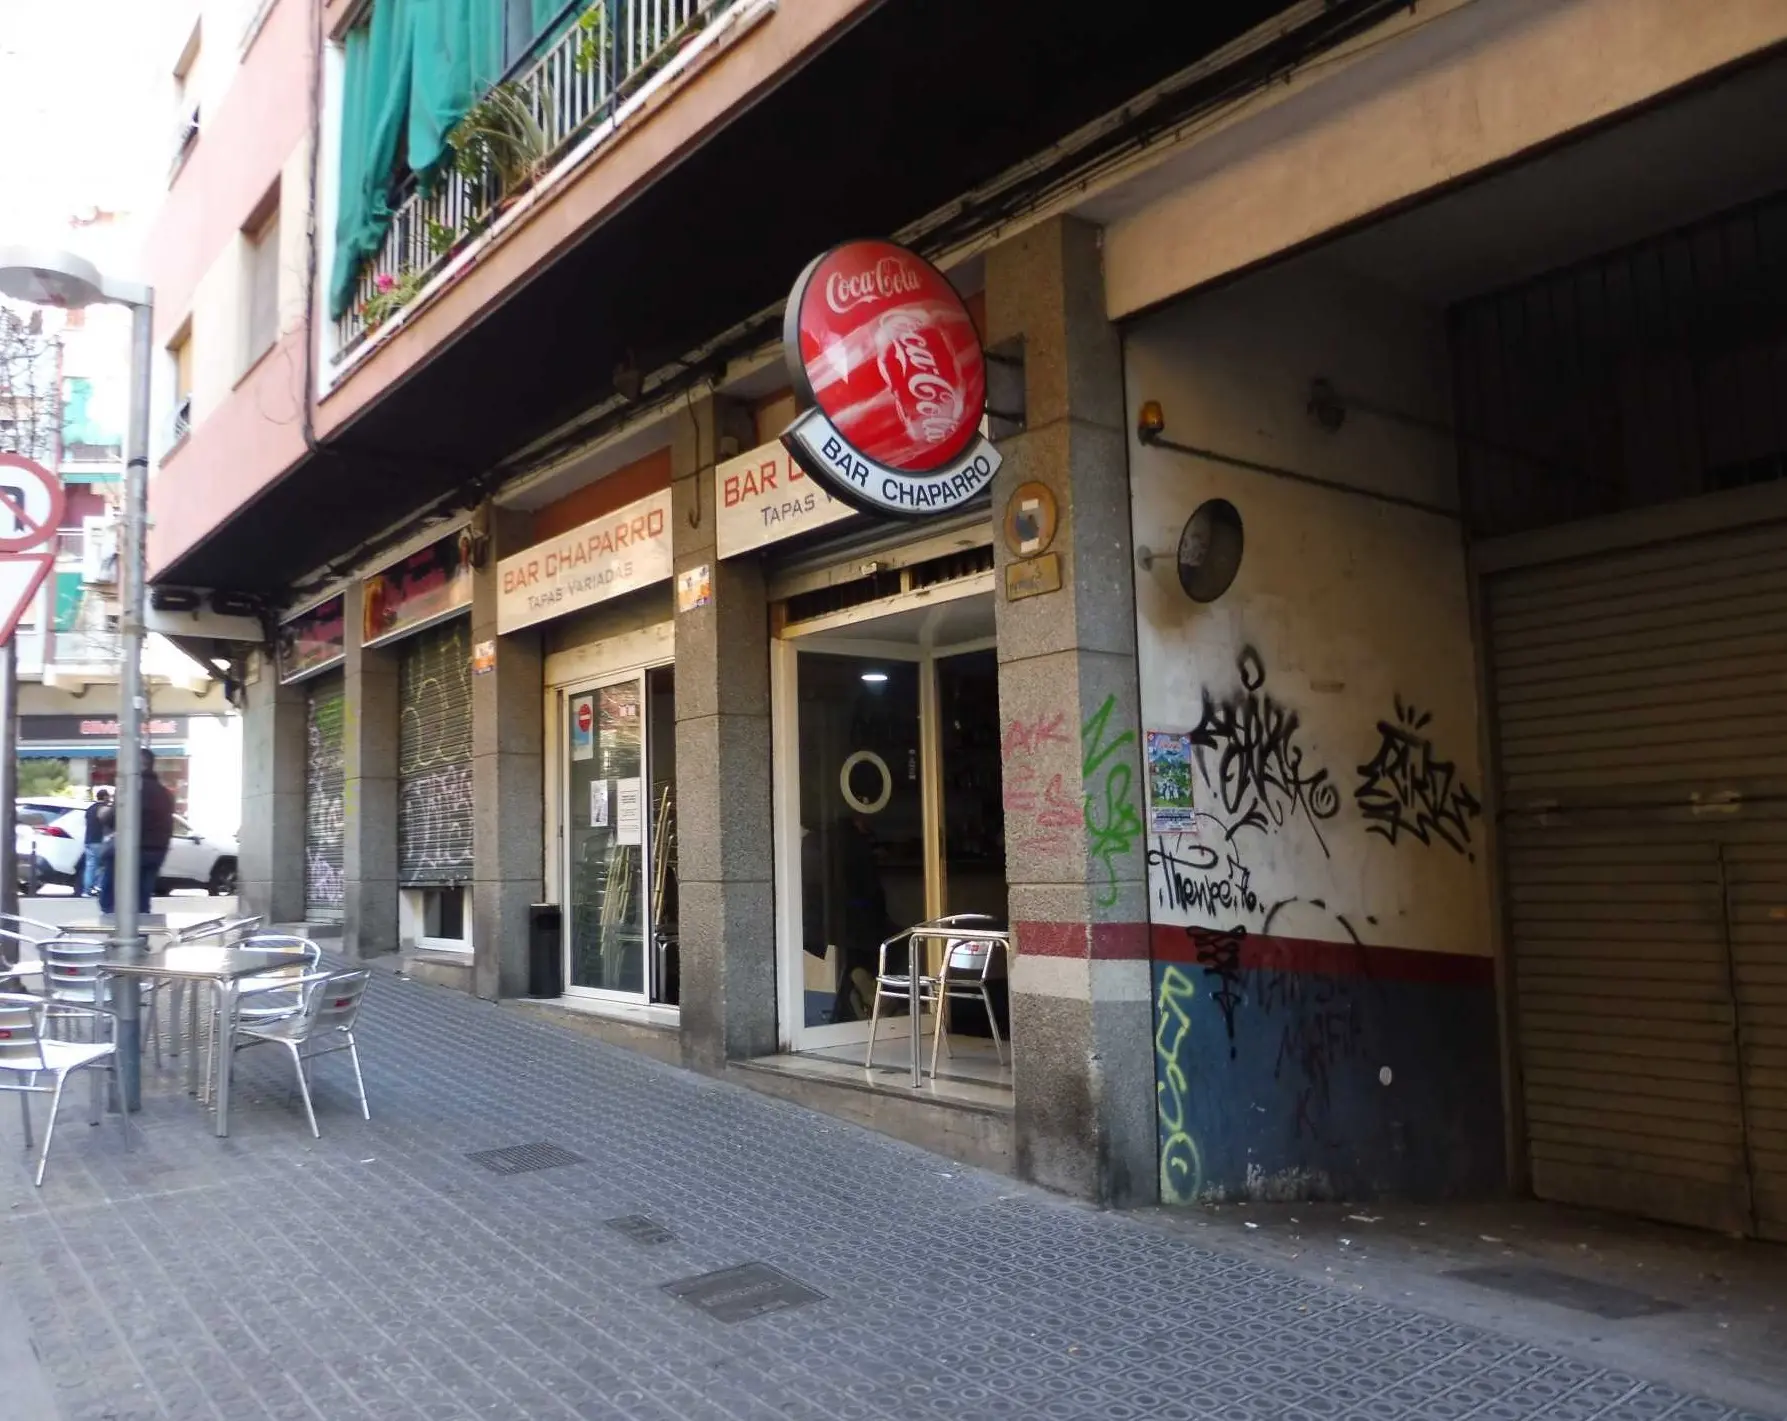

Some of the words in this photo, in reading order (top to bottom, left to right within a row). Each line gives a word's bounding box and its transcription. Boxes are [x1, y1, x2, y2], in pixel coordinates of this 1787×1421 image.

[826, 256, 922, 314] Coca-Cola
[724, 460, 778, 508] BAR
[821, 436, 869, 487] BAR
[882, 455, 991, 507] CHAPARRO
[761, 493, 816, 527] TAPAS
[503, 560, 540, 595] BAR
[545, 508, 664, 578] CHAPARRO
[527, 588, 563, 610] TAPAS
[567, 561, 634, 596] VARIADAS
